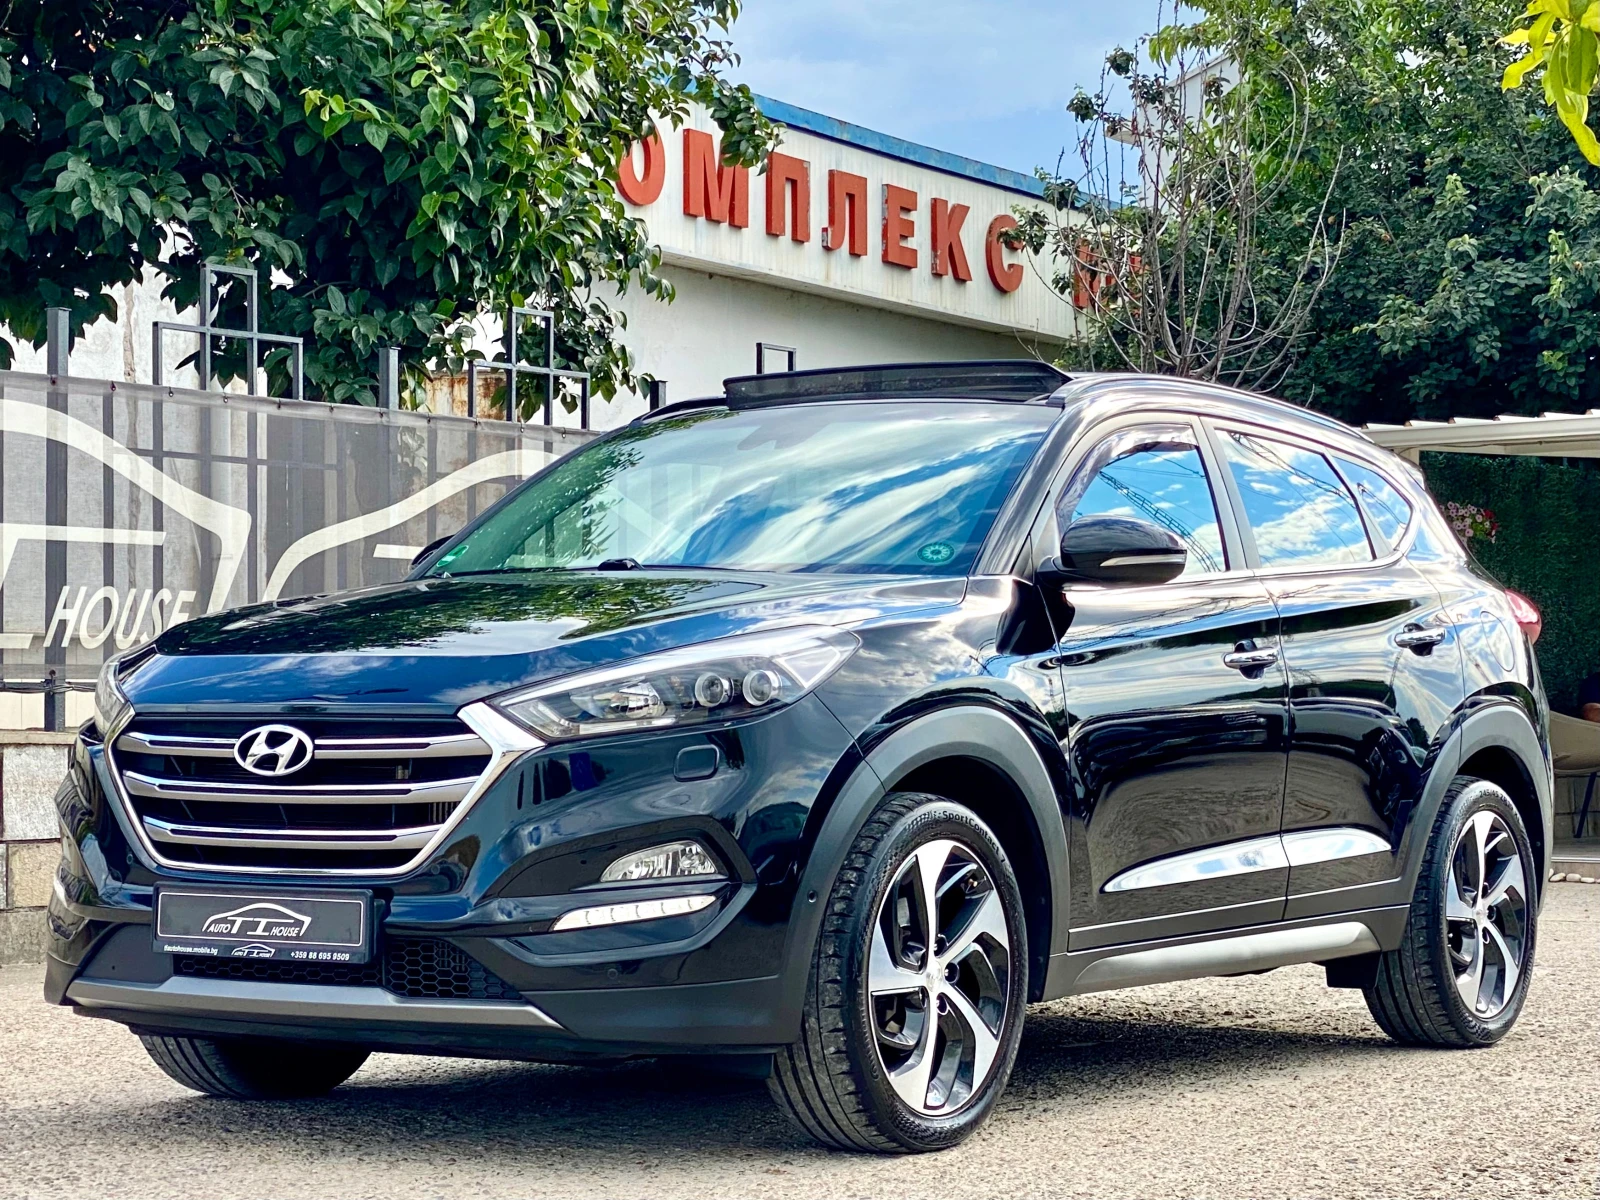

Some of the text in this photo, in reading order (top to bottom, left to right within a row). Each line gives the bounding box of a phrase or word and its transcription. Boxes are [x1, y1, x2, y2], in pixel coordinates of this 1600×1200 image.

[942, 810, 1000, 856] SportContact
[207, 923, 231, 933] AUTO
[270, 926, 300, 937] HOUSE
[290, 951, 350, 961] +359 88 695 9509
